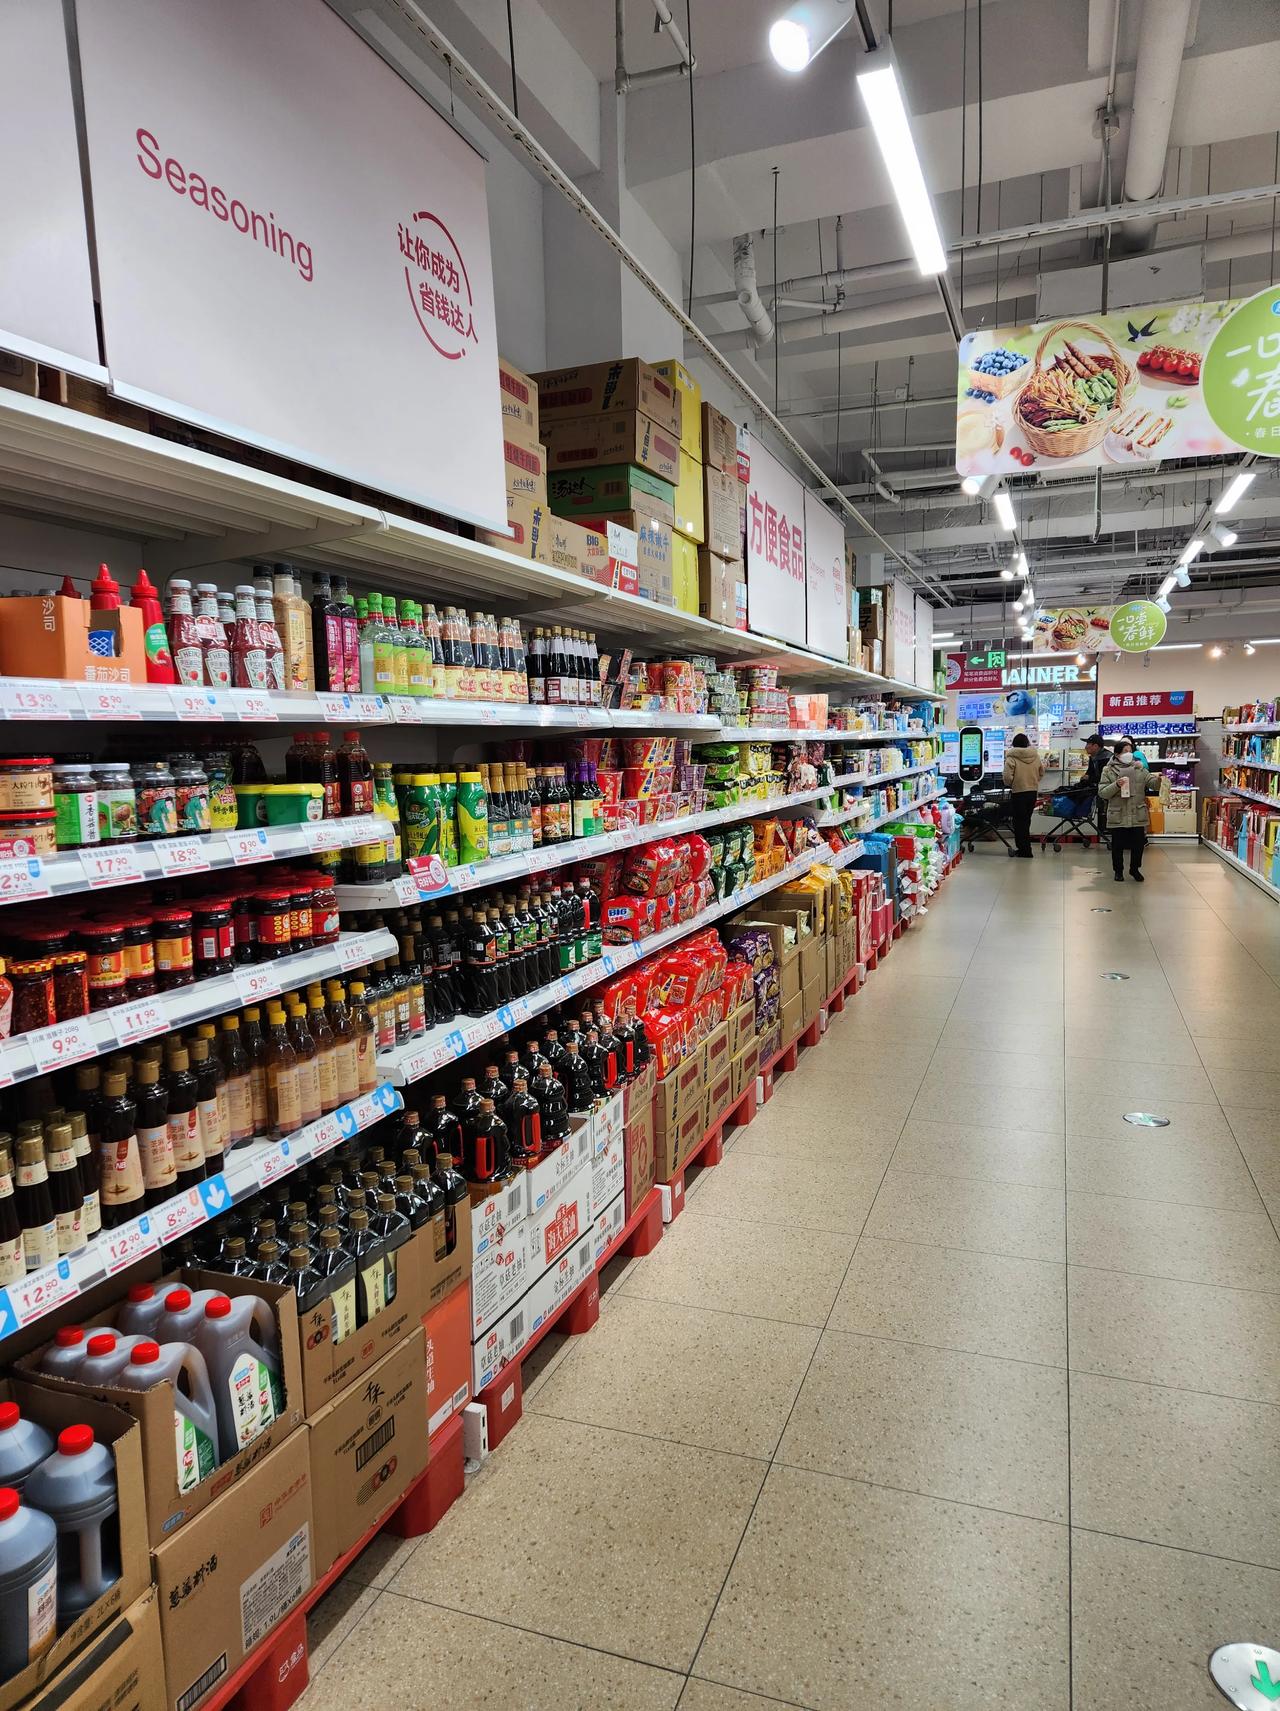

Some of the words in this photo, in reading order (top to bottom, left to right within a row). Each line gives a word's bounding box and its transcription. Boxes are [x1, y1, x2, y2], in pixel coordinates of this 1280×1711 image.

[136, 128, 313, 282] Seasoning
[397, 222, 460, 294] 让你成为
[418, 281, 479, 345] 省钱达人
[749, 491, 804, 583] 方便食品
[84, 665, 131, 683] 番茄沙司
[1109, 694, 1161, 707] 新品推荐
[608, 908, 628, 917] BIG
[126, 1009, 155, 1029] 11.90
[52, 1035, 78, 1054] 9.90
[110, 1232, 140, 1258] 12.90
[23, 1278, 58, 1307] 12.80
[426, 1338, 436, 1395] 头道生抽
